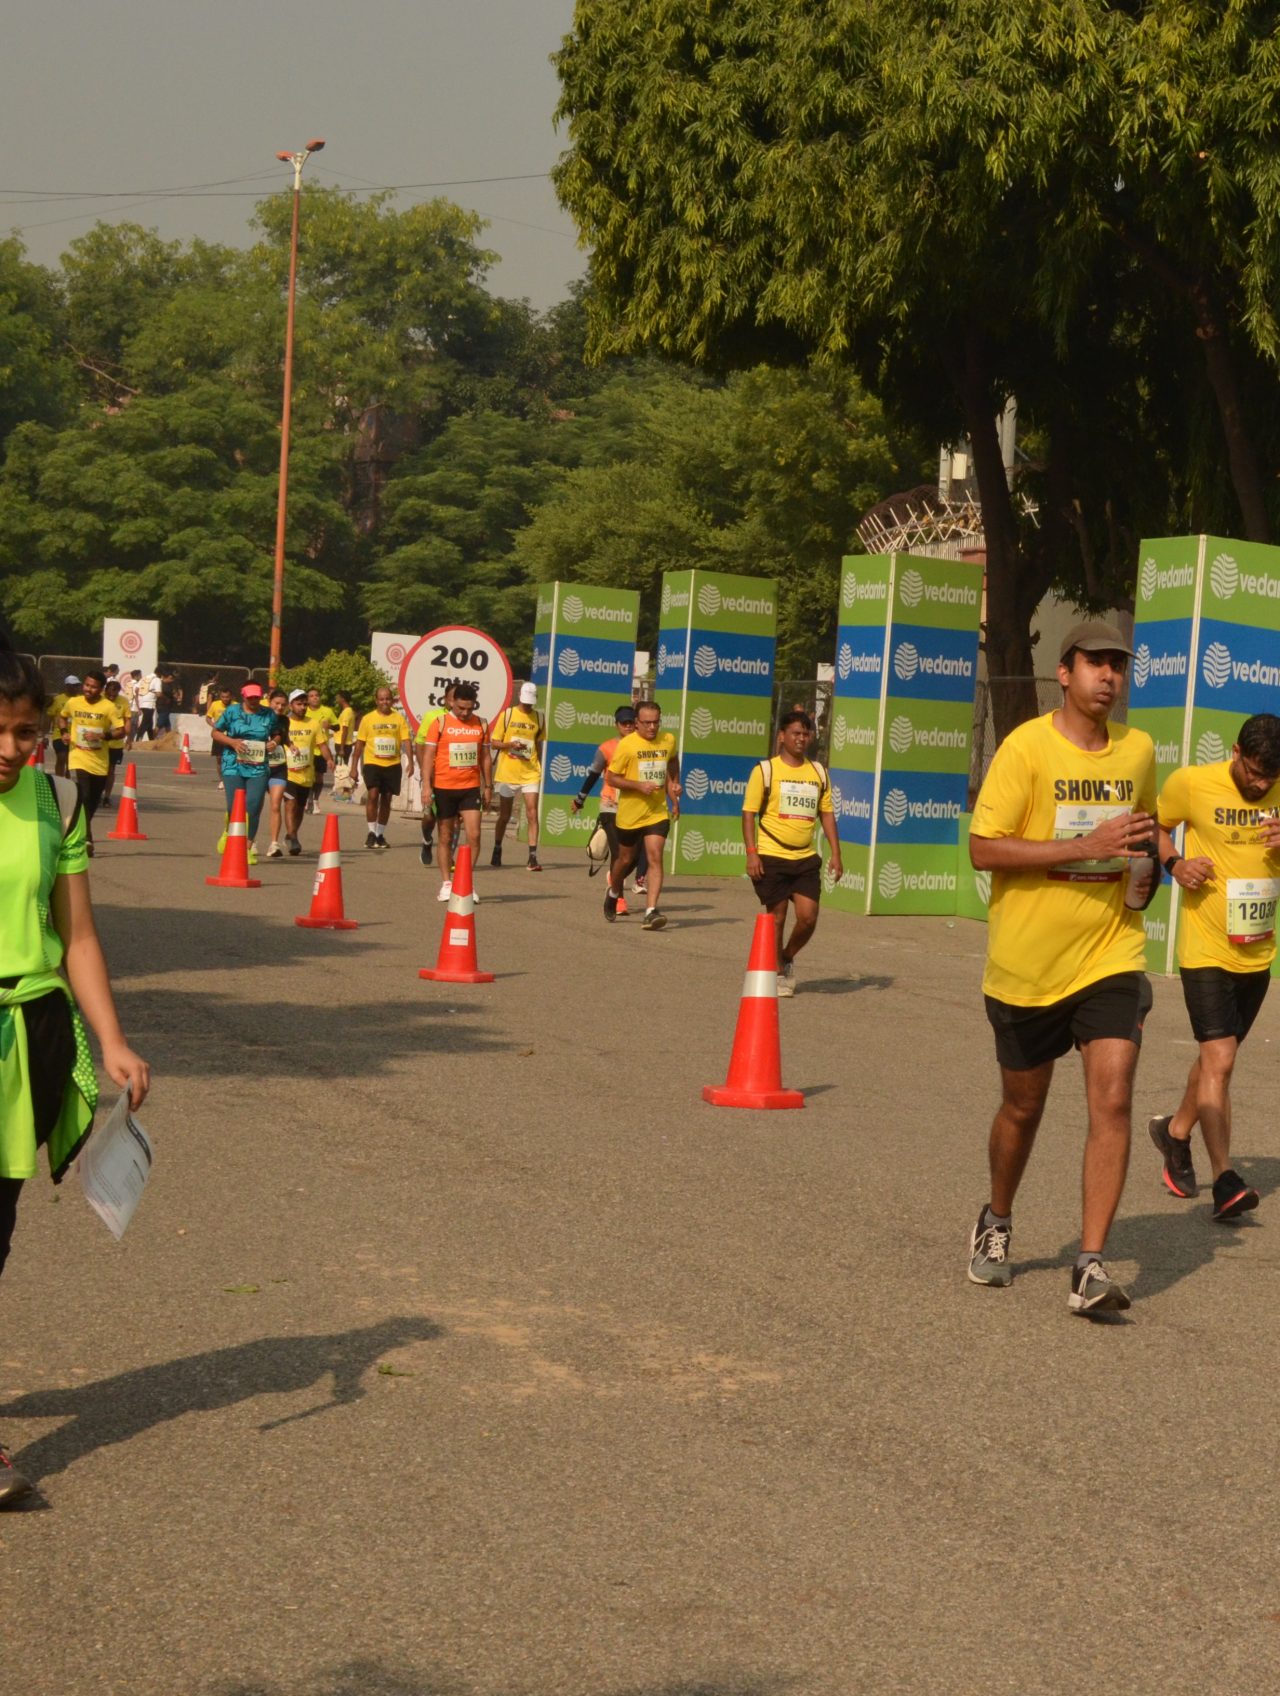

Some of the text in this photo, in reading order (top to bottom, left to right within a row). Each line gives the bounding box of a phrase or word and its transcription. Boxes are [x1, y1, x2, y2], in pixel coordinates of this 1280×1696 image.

[1157, 563, 1194, 589] vedanta
[856, 580, 886, 600] vedanta
[924, 583, 977, 605] vedanta
[584, 605, 633, 623] vedanta
[722, 596, 773, 614] vedanta
[431, 645, 489, 671] 200
[580, 659, 629, 675] vedanta
[718, 657, 769, 675] vedanta
[851, 652, 881, 672] vedanta
[919, 655, 972, 676] vedanta
[1150, 651, 1187, 677] vedanta
[577, 711, 615, 727] vedan
[713, 717, 765, 735] vedanta
[447, 727, 480, 736] Optum
[846, 725, 875, 746] vedanta
[914, 728, 967, 748] vedanta
[454, 752, 477, 761] 11132
[1054, 779, 1133, 802] SHOW UP
[786, 795, 816, 809] 12456
[841, 796, 870, 819] vedanta
[908, 799, 961, 819] vedanta
[1214, 807, 1264, 827] SHOW
[705, 839, 747, 856] vedan
[836, 869, 864, 891] edanta
[903, 871, 957, 890] vedanta
